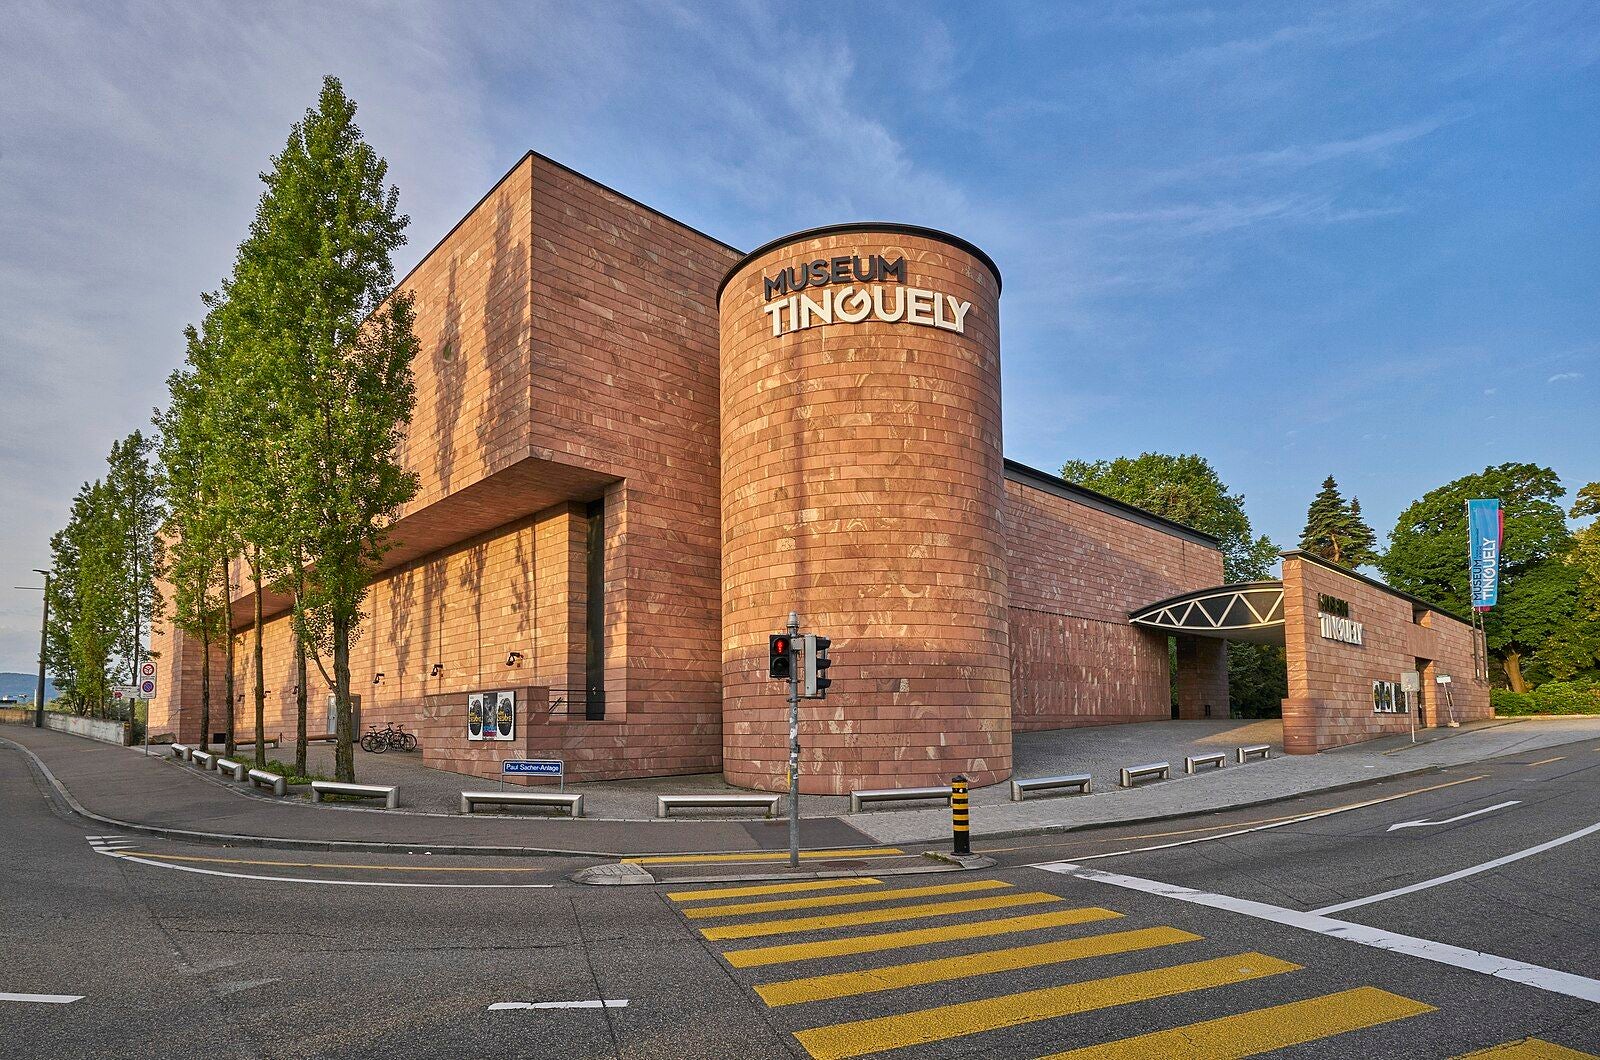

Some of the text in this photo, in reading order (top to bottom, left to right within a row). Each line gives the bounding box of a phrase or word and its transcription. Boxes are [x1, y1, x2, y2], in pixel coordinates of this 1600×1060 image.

[764, 254, 907, 300] MUSEUM
[764, 285, 971, 337] TINGUELY
[1473, 559, 1482, 601] MUSEUM
[1483, 537, 1496, 601] TINGUELY
[1318, 612, 1362, 645] TINGUELY
[506, 763, 560, 773] Paul Sacher-Anlage
